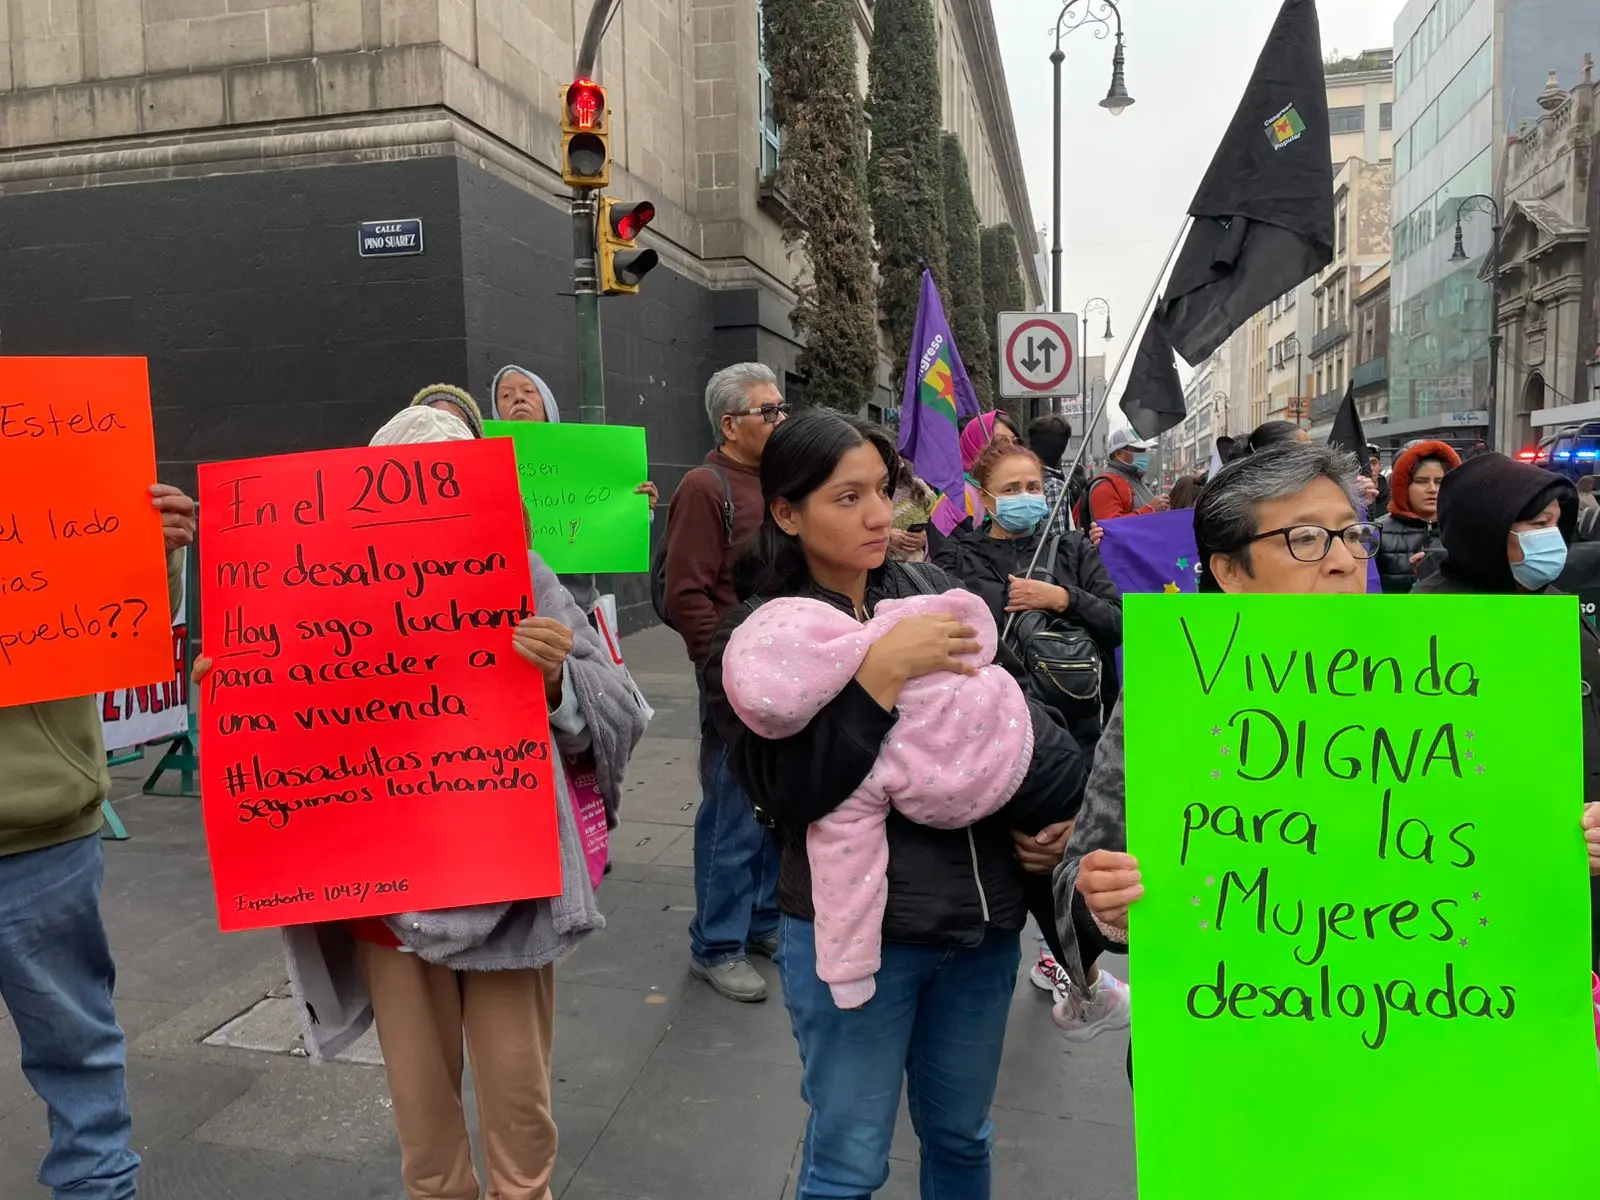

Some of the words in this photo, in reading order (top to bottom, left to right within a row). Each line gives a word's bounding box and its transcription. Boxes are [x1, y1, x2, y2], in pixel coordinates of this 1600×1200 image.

[364, 237, 384, 249] PINO
[385, 233, 416, 248] SUAREZ
[375, 224, 402, 234] CALLE
[1, 400, 127, 437] Estela
[294, 469, 325, 525] el
[347, 458, 461, 513] 2018
[584, 486, 611, 505] 60
[48, 509, 120, 540] lado
[217, 560, 271, 589] me
[283, 543, 507, 598] desalojaron
[0, 598, 149, 666] pueblo??
[224, 605, 281, 658] Hoy
[296, 619, 373, 657] sigo
[1179, 611, 1480, 697] Vivienda
[210, 667, 275, 705] para
[288, 652, 440, 685] acceder
[468, 649, 497, 668] a
[218, 713, 278, 736] una
[293, 684, 469, 730] vivienda
[431, 738, 549, 776] mayores
[1228, 708, 1463, 785] DIGNA
[386, 767, 539, 797] luchando
[1180, 801, 1318, 866] para
[1377, 788, 1476, 868] las
[1215, 866, 1460, 966] Mujeres
[1185, 960, 1517, 1050] desalojadas
